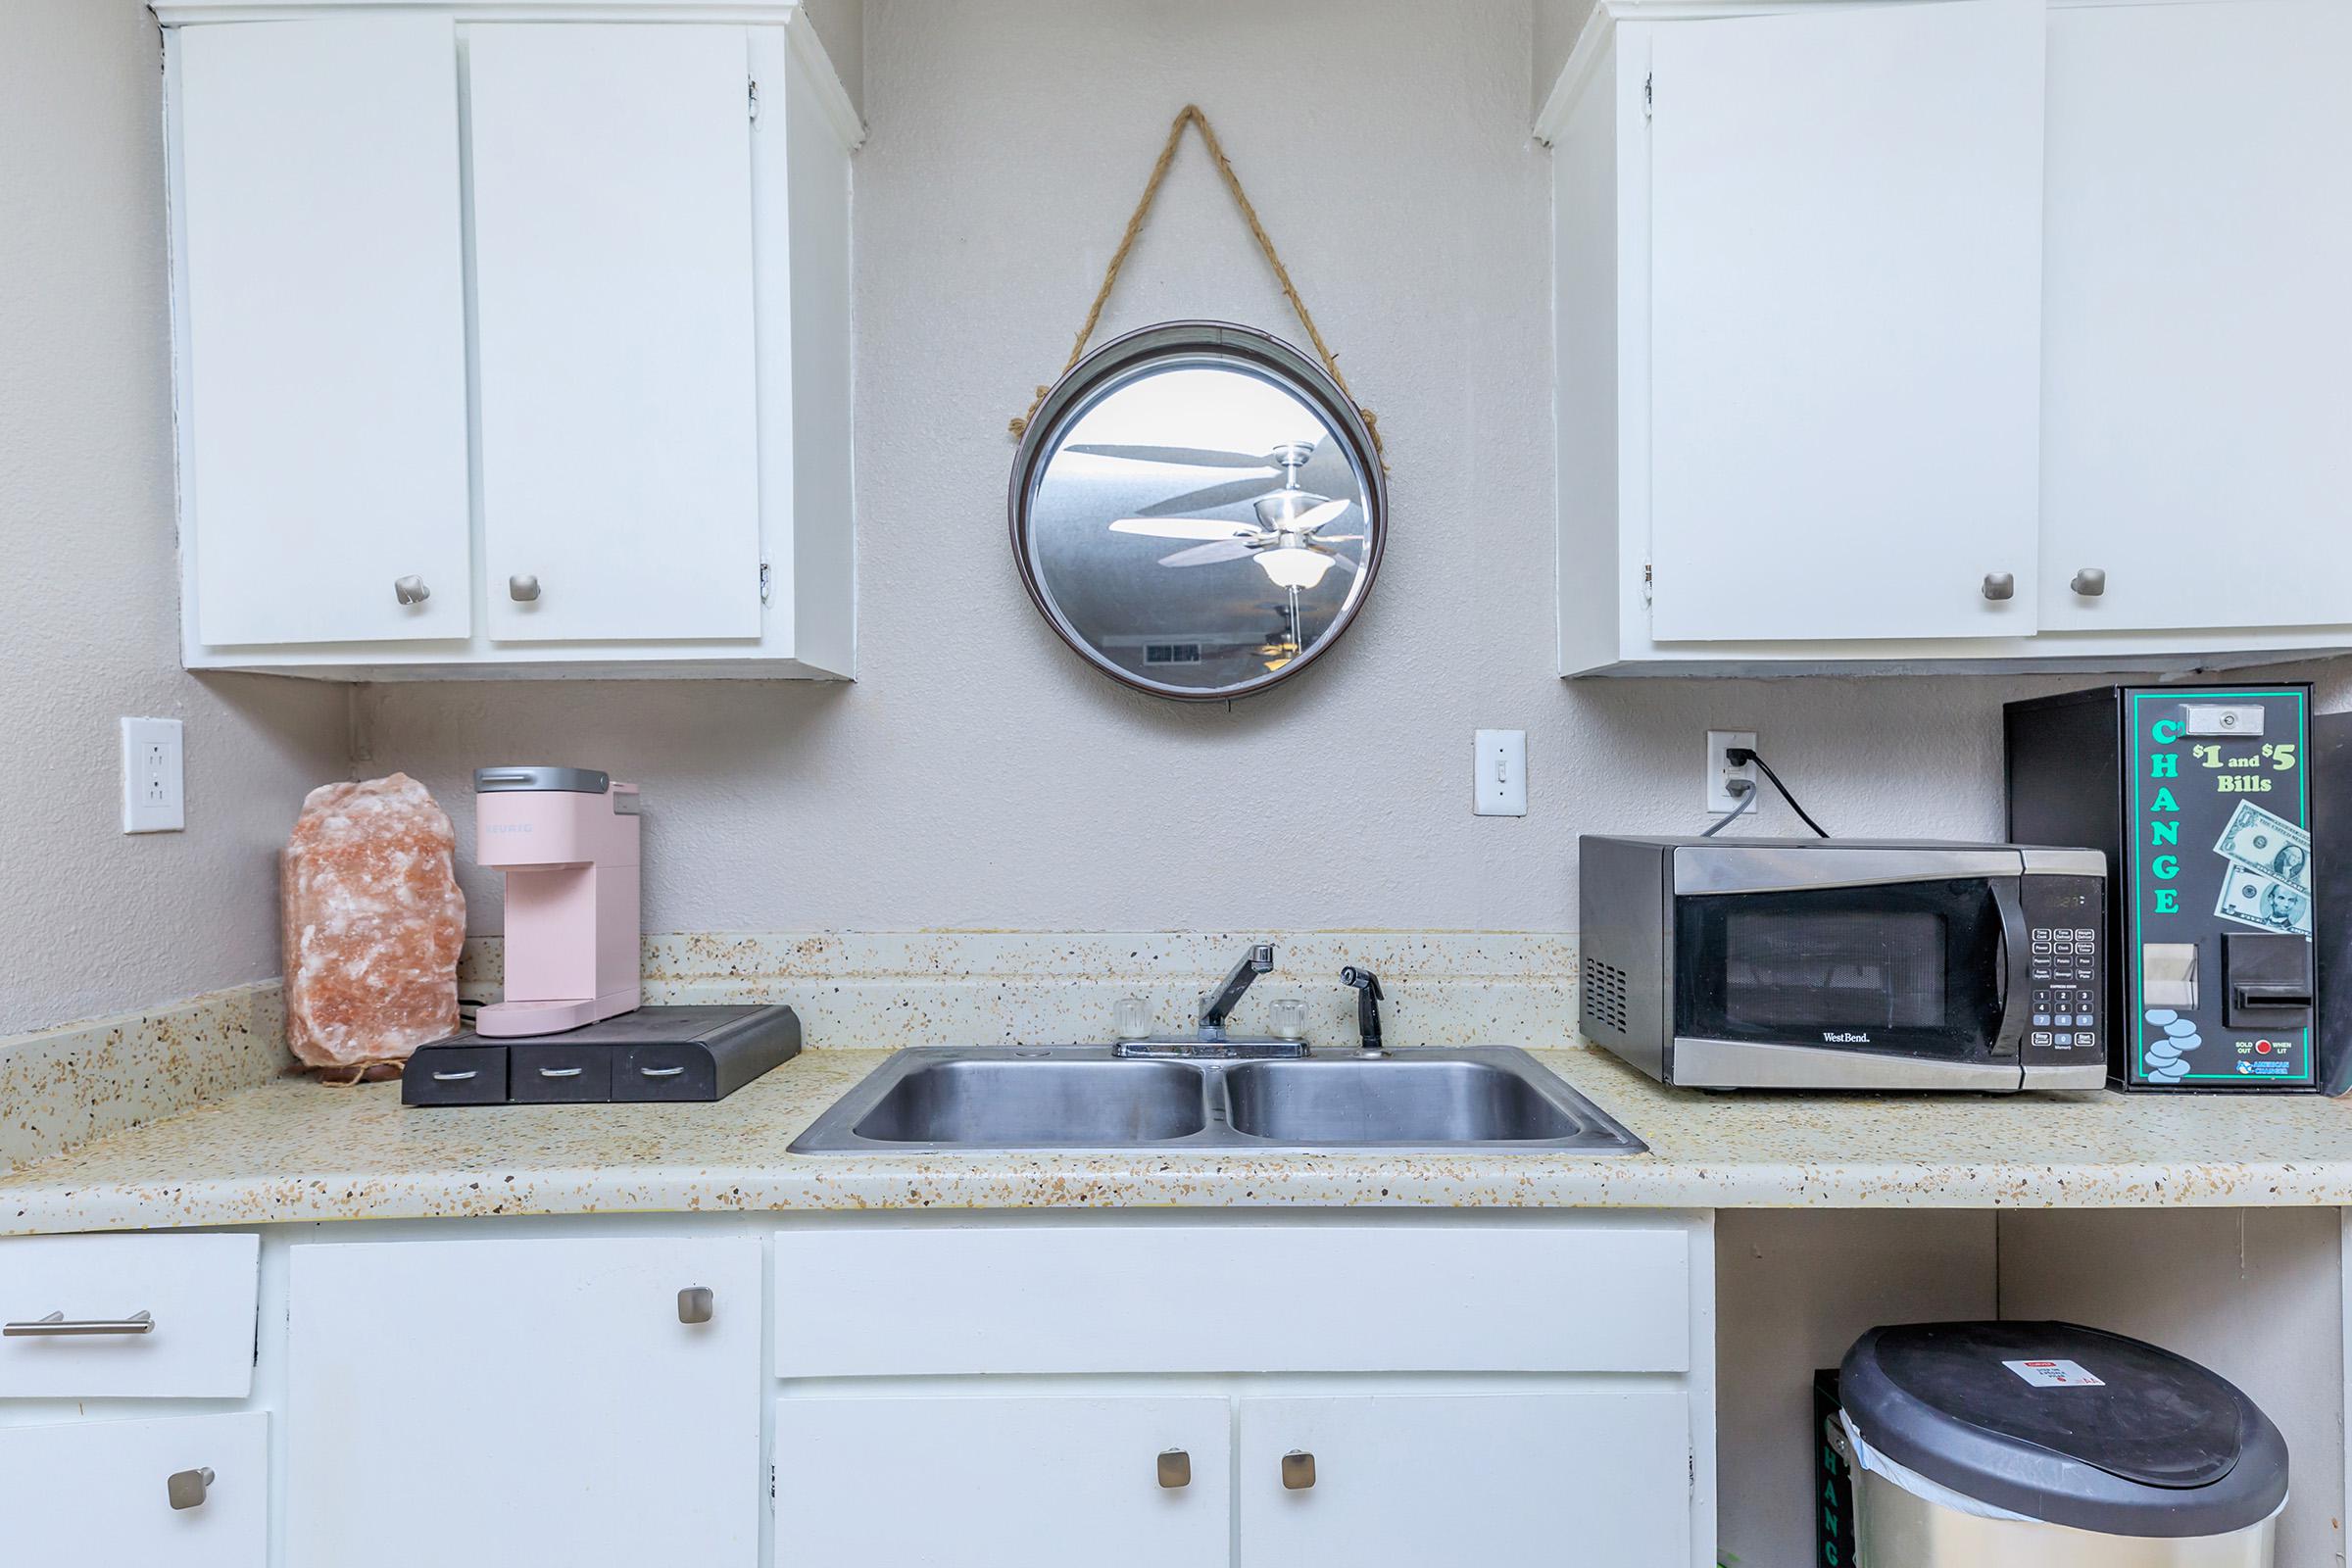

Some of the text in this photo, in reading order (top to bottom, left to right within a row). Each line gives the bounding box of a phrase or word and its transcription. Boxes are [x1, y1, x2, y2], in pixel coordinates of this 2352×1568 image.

[2193, 743, 2296, 771] $1 and $5
[2217, 774, 2272, 792] Bills
[2150, 719, 2180, 913] CHANGE
